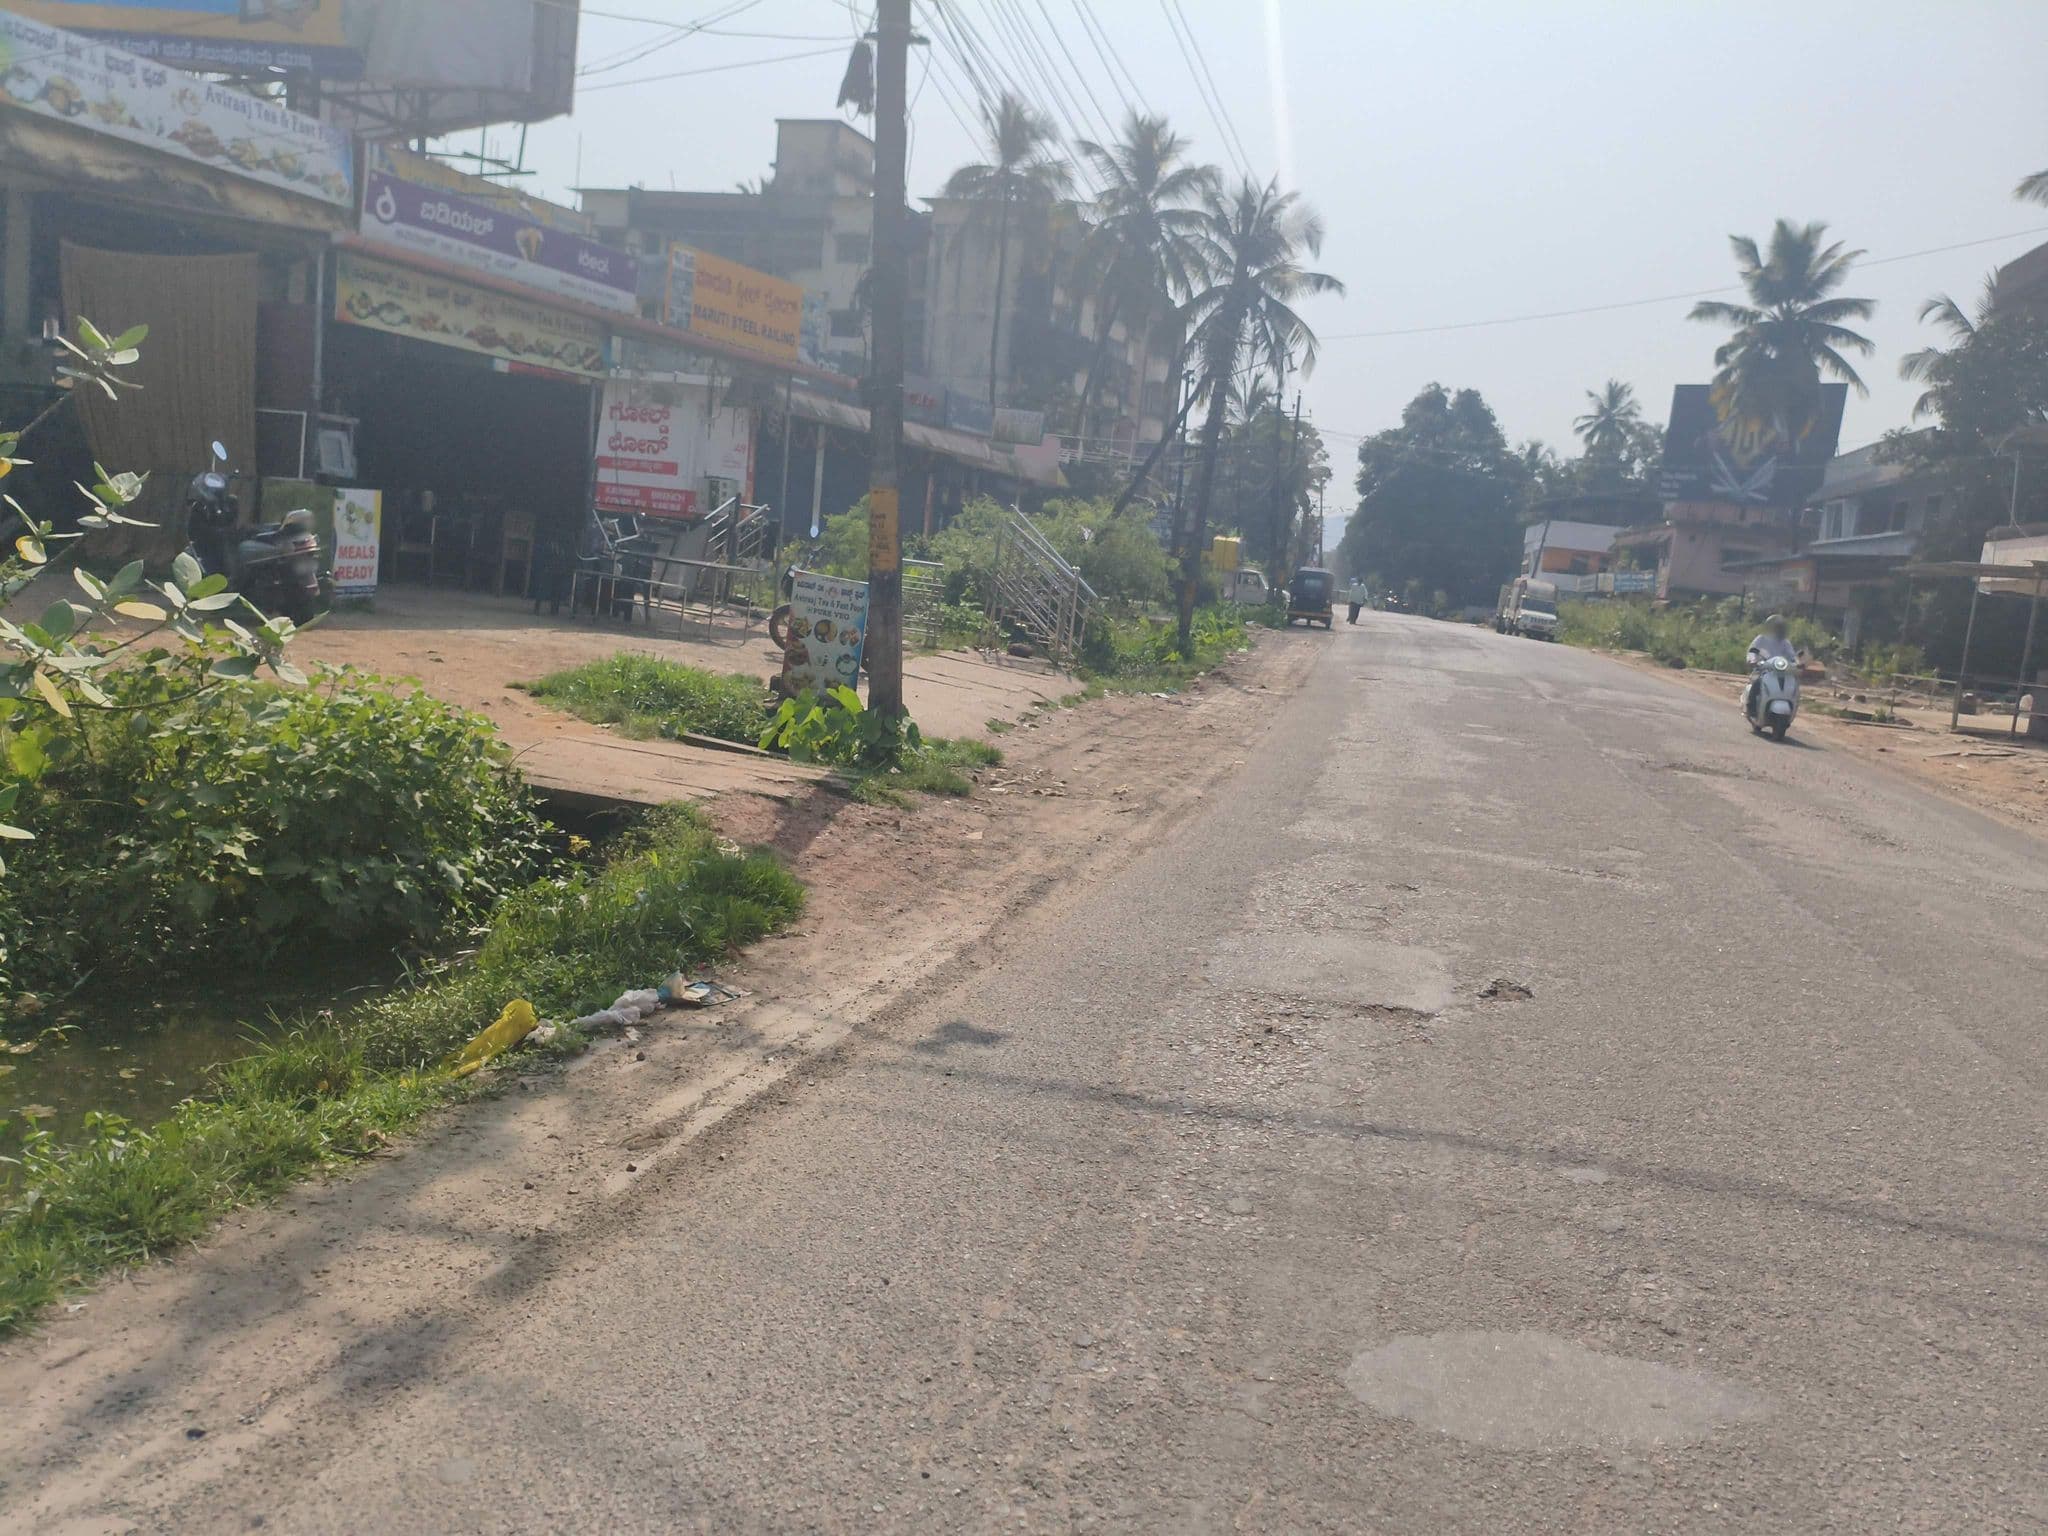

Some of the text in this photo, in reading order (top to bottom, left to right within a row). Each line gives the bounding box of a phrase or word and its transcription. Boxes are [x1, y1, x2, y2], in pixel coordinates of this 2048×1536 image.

[732, 314, 759, 337] STEEL
[338, 545, 376, 560] MEALS
[336, 565, 374, 581] READY
